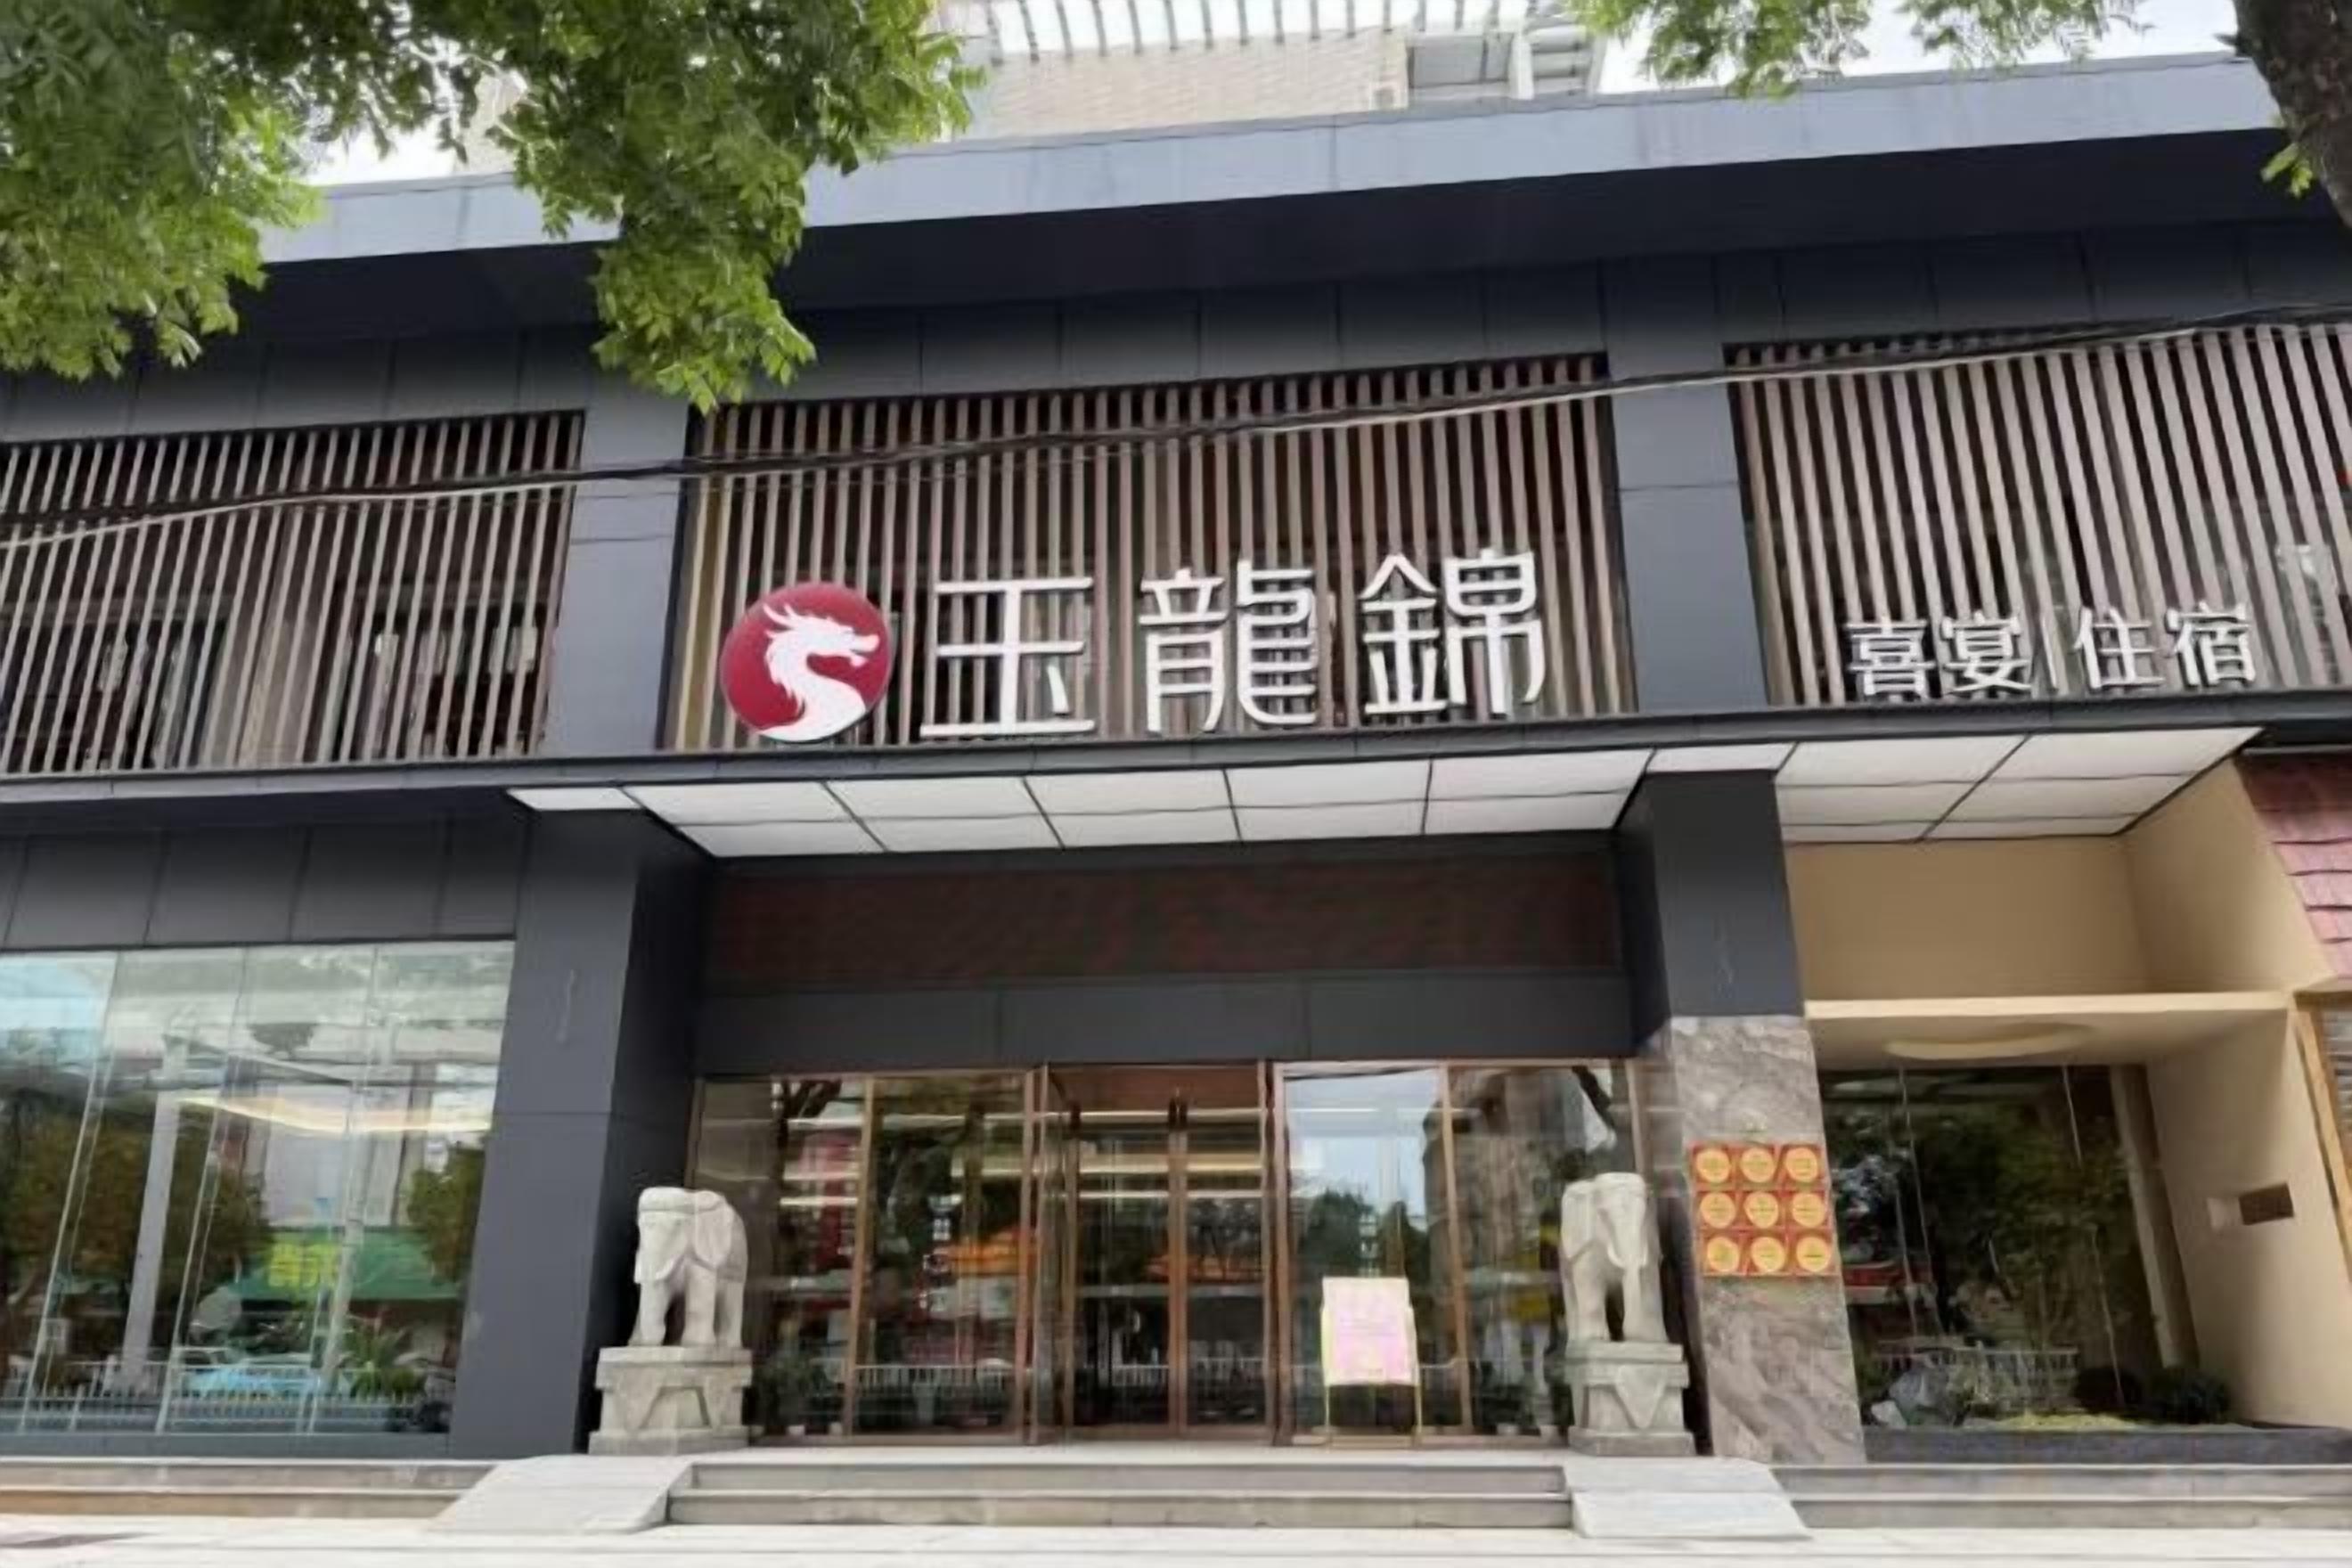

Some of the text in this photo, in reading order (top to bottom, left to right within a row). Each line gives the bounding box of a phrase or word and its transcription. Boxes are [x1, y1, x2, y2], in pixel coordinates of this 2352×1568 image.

[919, 548, 1545, 738] 玉龍錦
[1847, 601, 2256, 696] 喜宴 住宿
